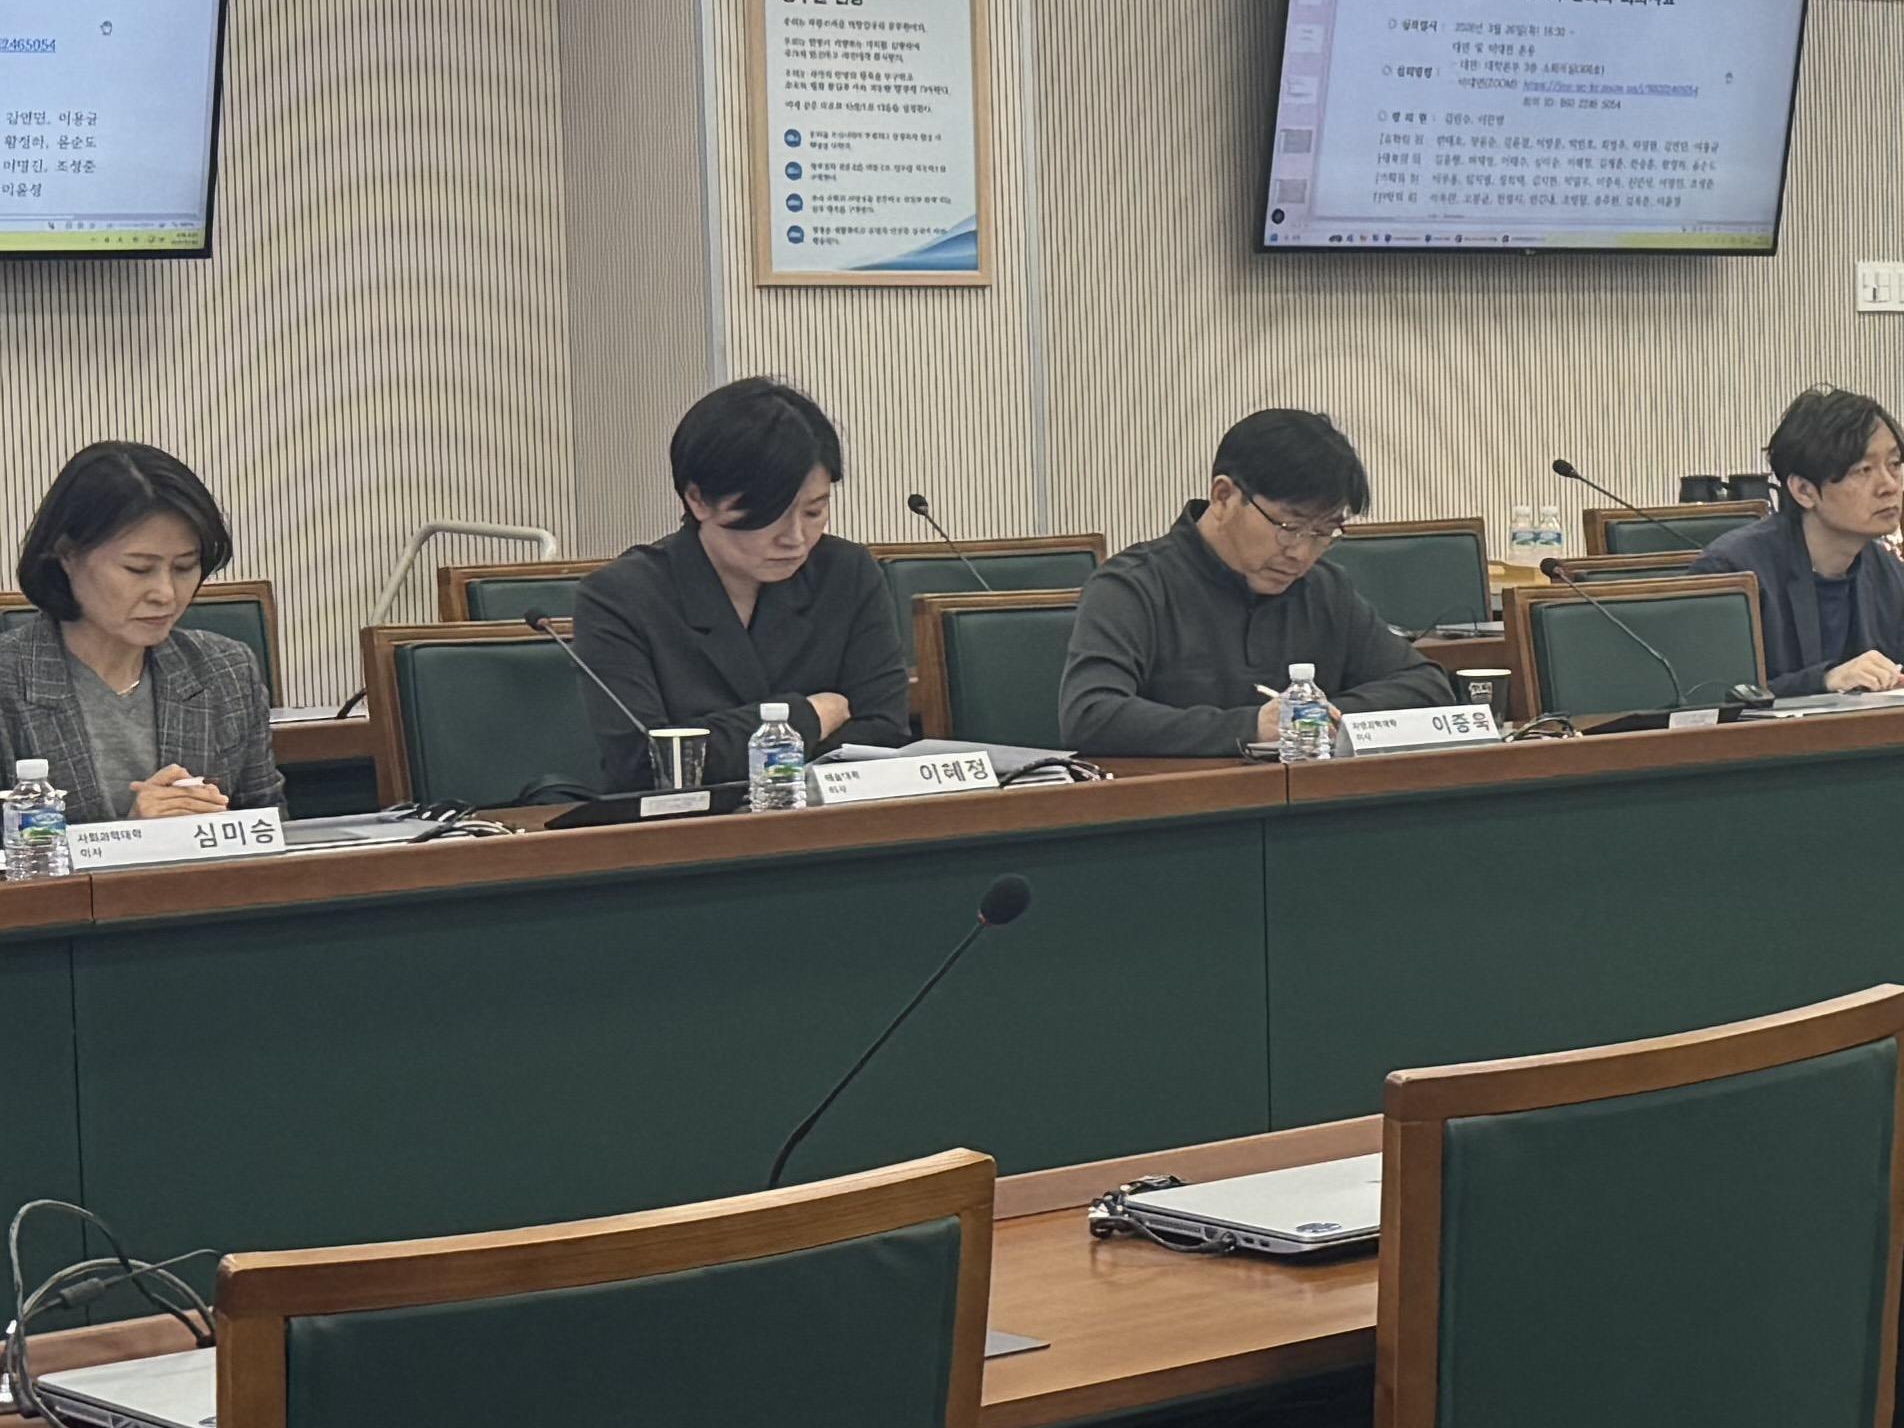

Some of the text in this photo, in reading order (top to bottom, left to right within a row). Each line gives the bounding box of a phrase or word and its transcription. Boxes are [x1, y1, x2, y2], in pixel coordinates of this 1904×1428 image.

[919, 758, 989, 785] 이혜정
[77, 828, 142, 844] 사회과학대학
[194, 818, 275, 849] 심미승
